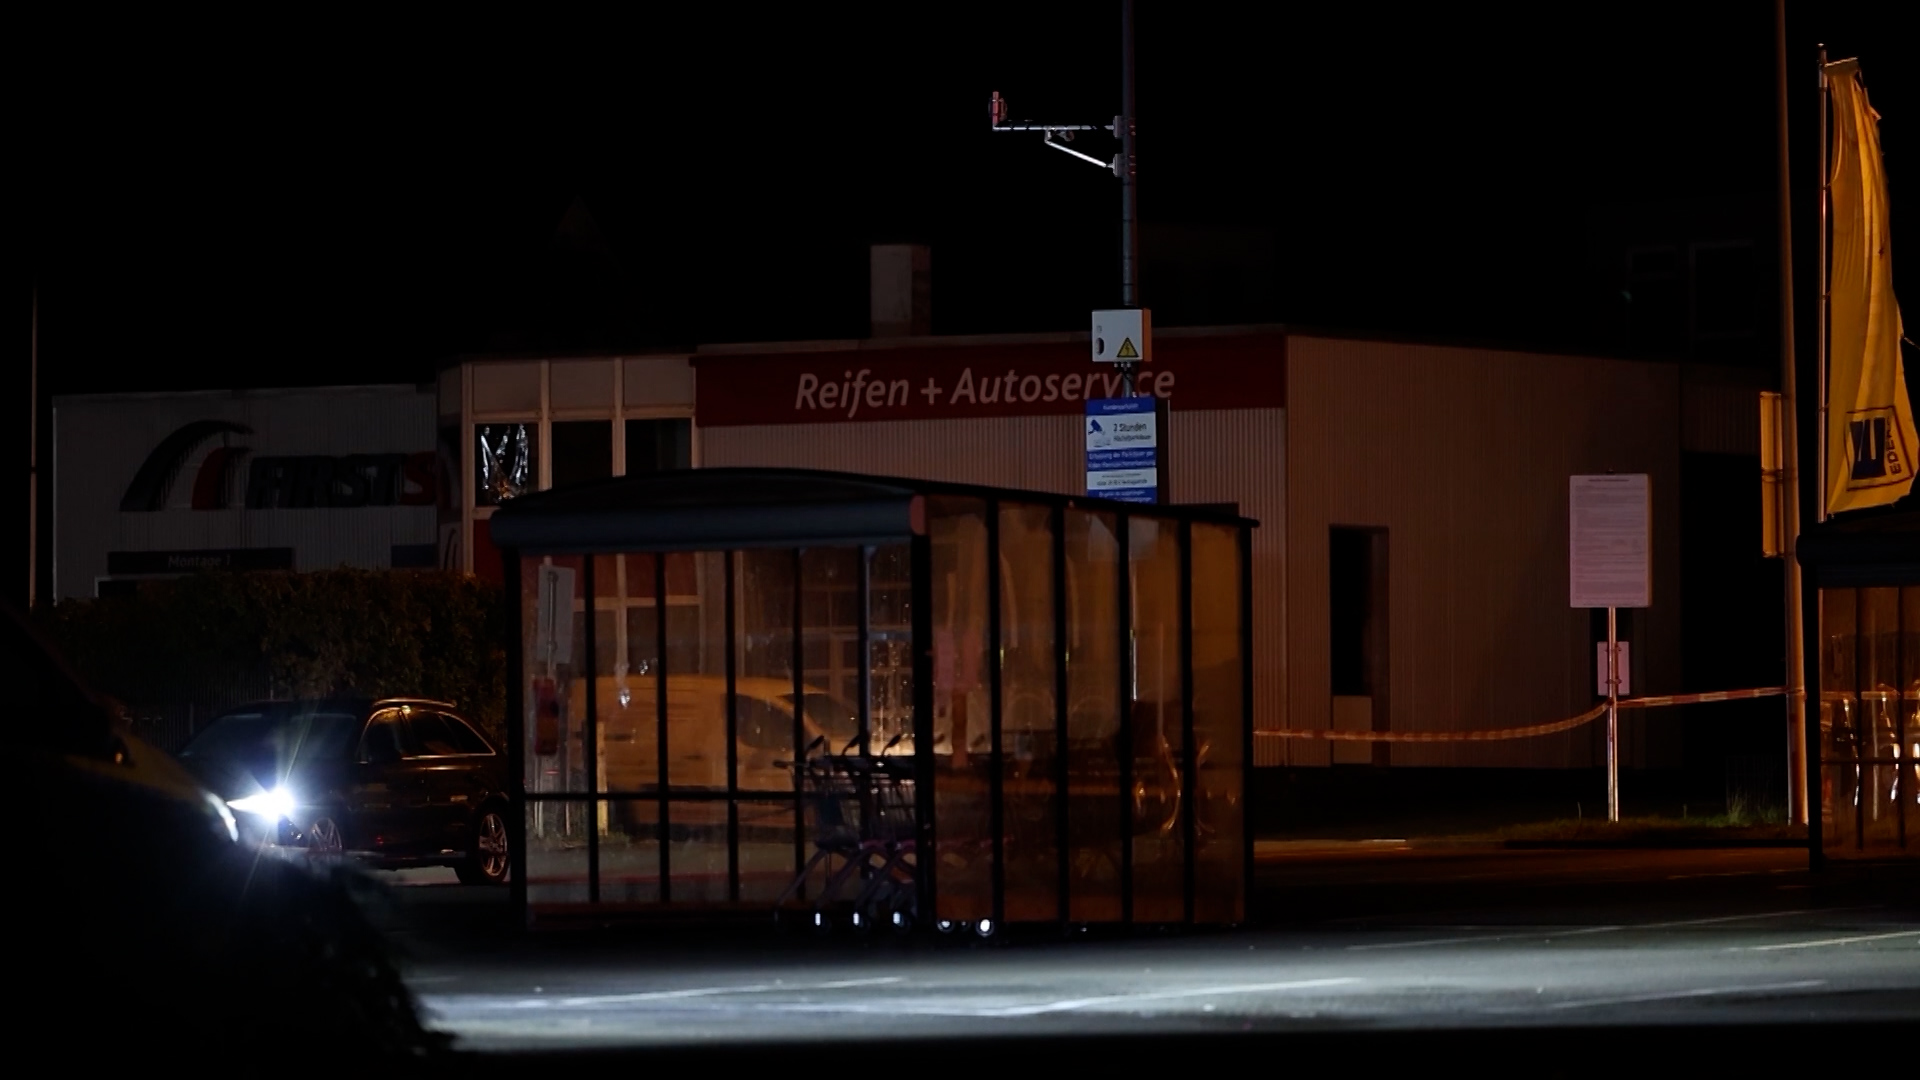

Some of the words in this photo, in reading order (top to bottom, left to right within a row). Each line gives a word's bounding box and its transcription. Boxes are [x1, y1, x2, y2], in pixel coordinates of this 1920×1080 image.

[795, 367, 911, 419] Reifen
[920, 377, 943, 405] +
[950, 366, 1176, 406] Autoservce
[1886, 416, 1902, 474] EDE
[168, 554, 222, 570] Montage
